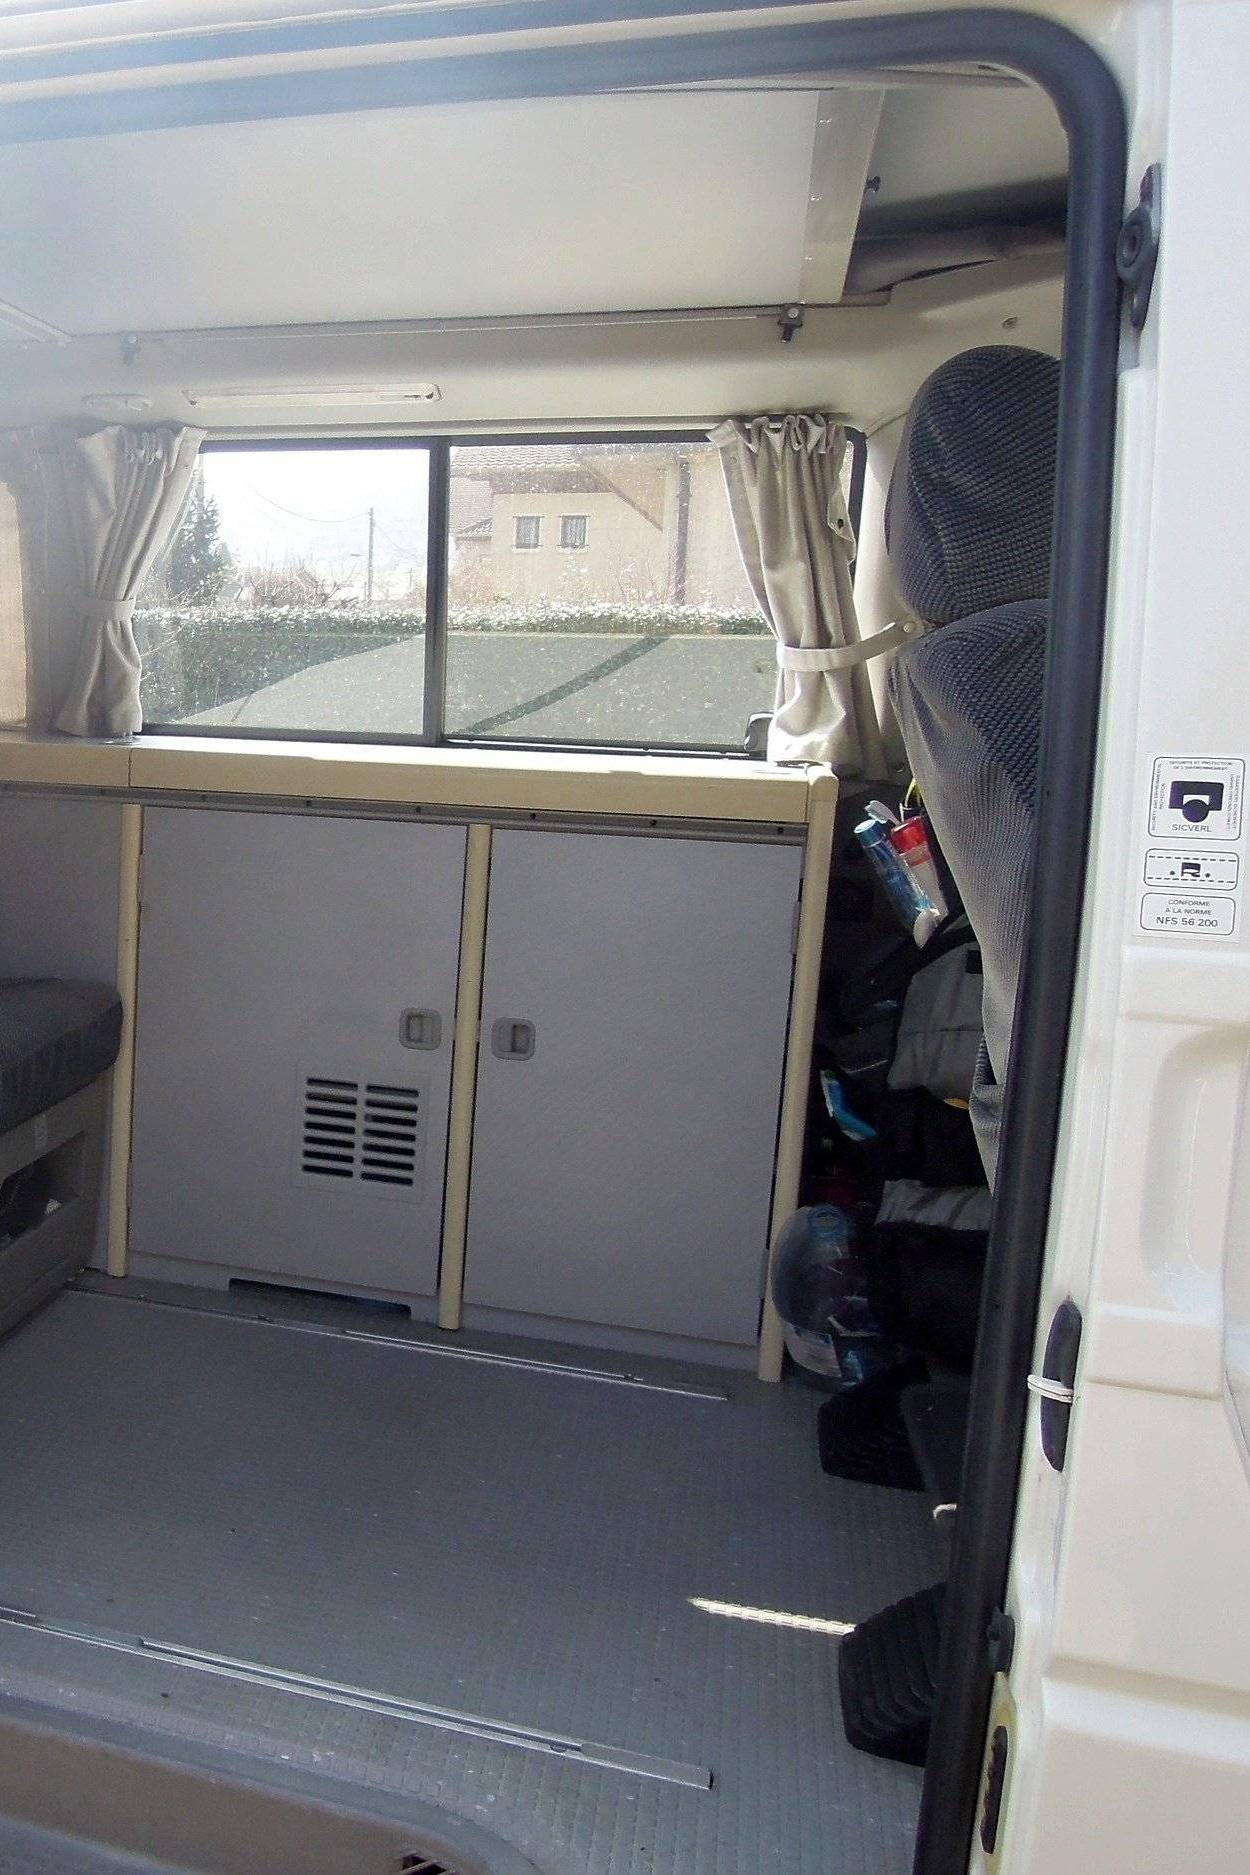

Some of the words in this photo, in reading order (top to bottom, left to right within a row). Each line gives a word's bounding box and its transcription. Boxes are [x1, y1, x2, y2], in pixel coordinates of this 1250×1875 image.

[1171, 823, 1212, 832] SICVERL
[1168, 899, 1210, 907] CONFORME
[1156, 916, 1178, 925] NFS
[1181, 917, 1195, 926] 56
[1197, 918, 1218, 927] 200
